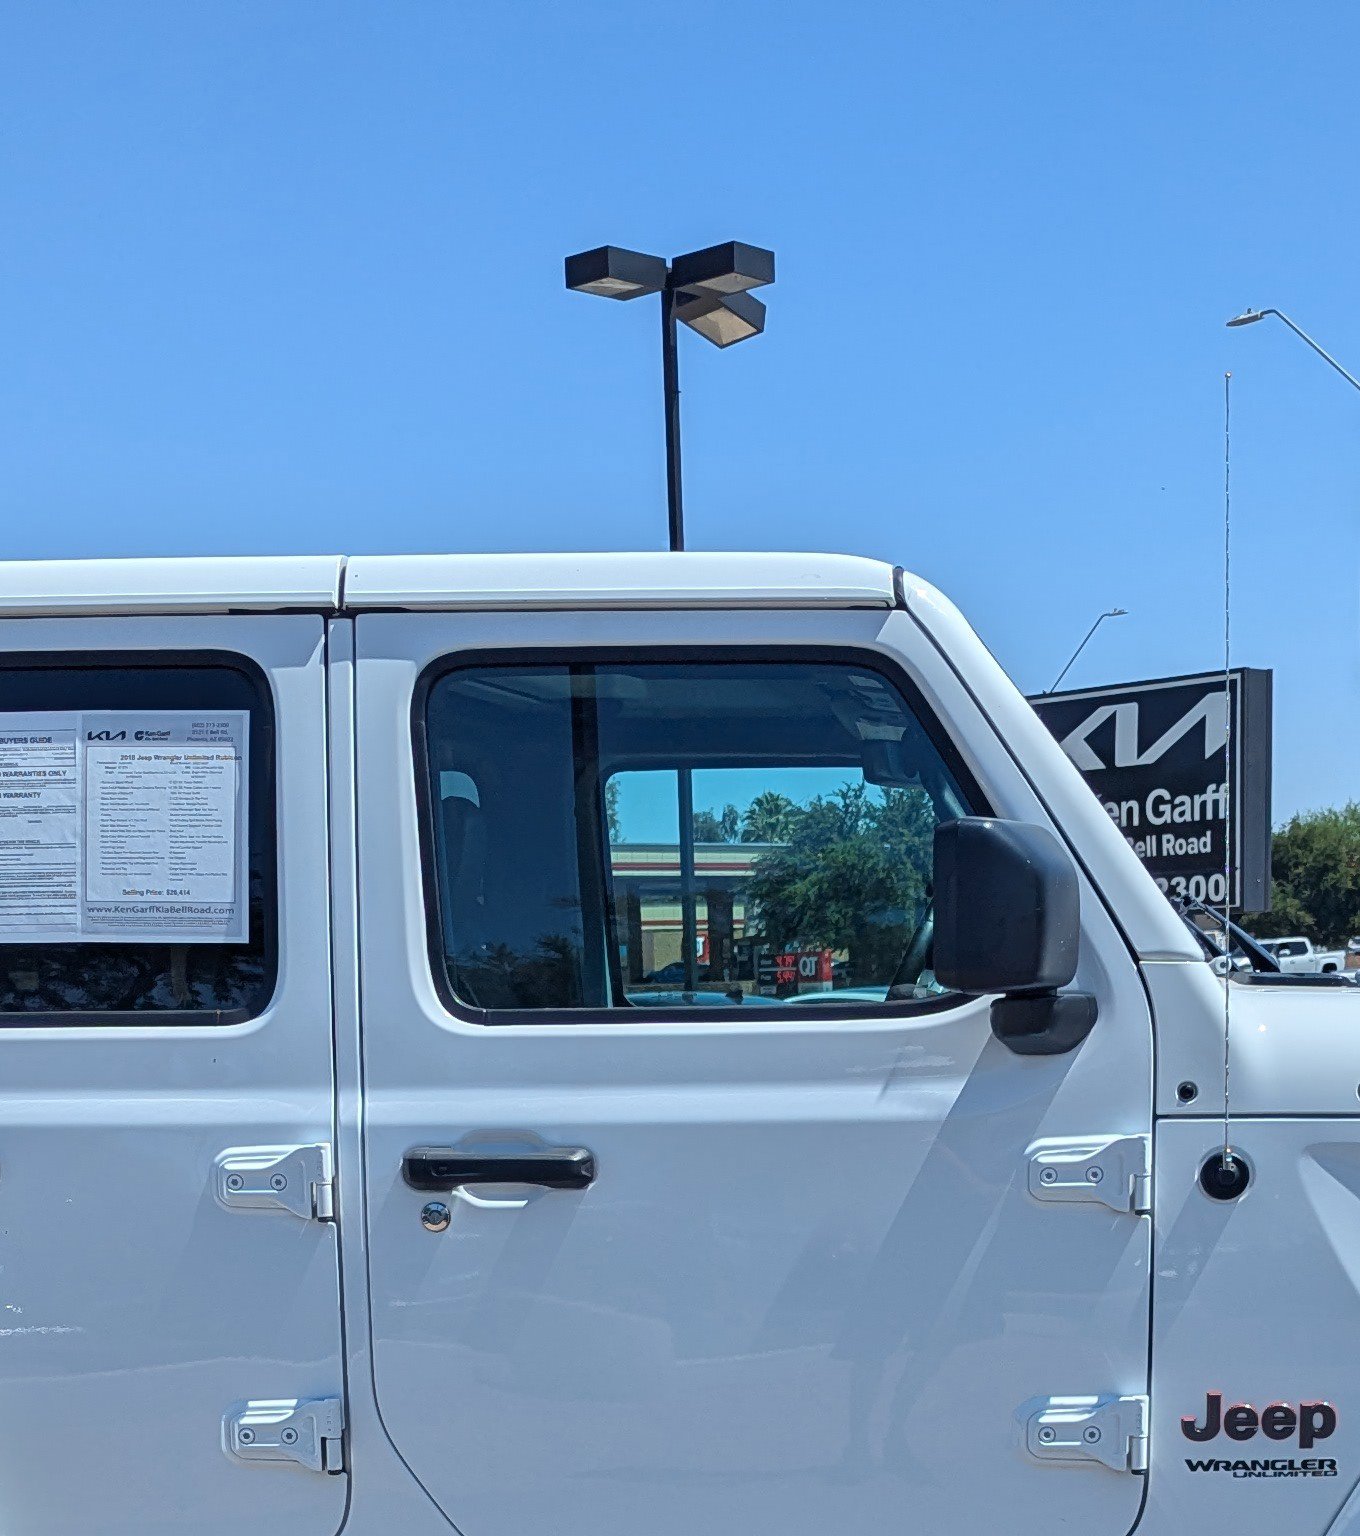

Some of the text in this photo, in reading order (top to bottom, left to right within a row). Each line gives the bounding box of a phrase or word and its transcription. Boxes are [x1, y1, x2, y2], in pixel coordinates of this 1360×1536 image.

[29, 736, 53, 744] GUIDE
[87, 730, 127, 741] KIA
[137, 754, 152, 762] Jeep
[154, 754, 182, 762] Wrangler
[2, 770, 46, 778] WARRANTIES
[2, 791, 42, 799] WARRANTY
[1096, 783, 1228, 828] en Garff
[1161, 830, 1212, 857] Road
[122, 889, 144, 897] Selling
[799, 956, 818, 977] QT
[1181, 1389, 1337, 1449] Jeep
[1185, 1458, 1337, 1473] WRANGLER
[1232, 1470, 1338, 1478] UNLIMITED
